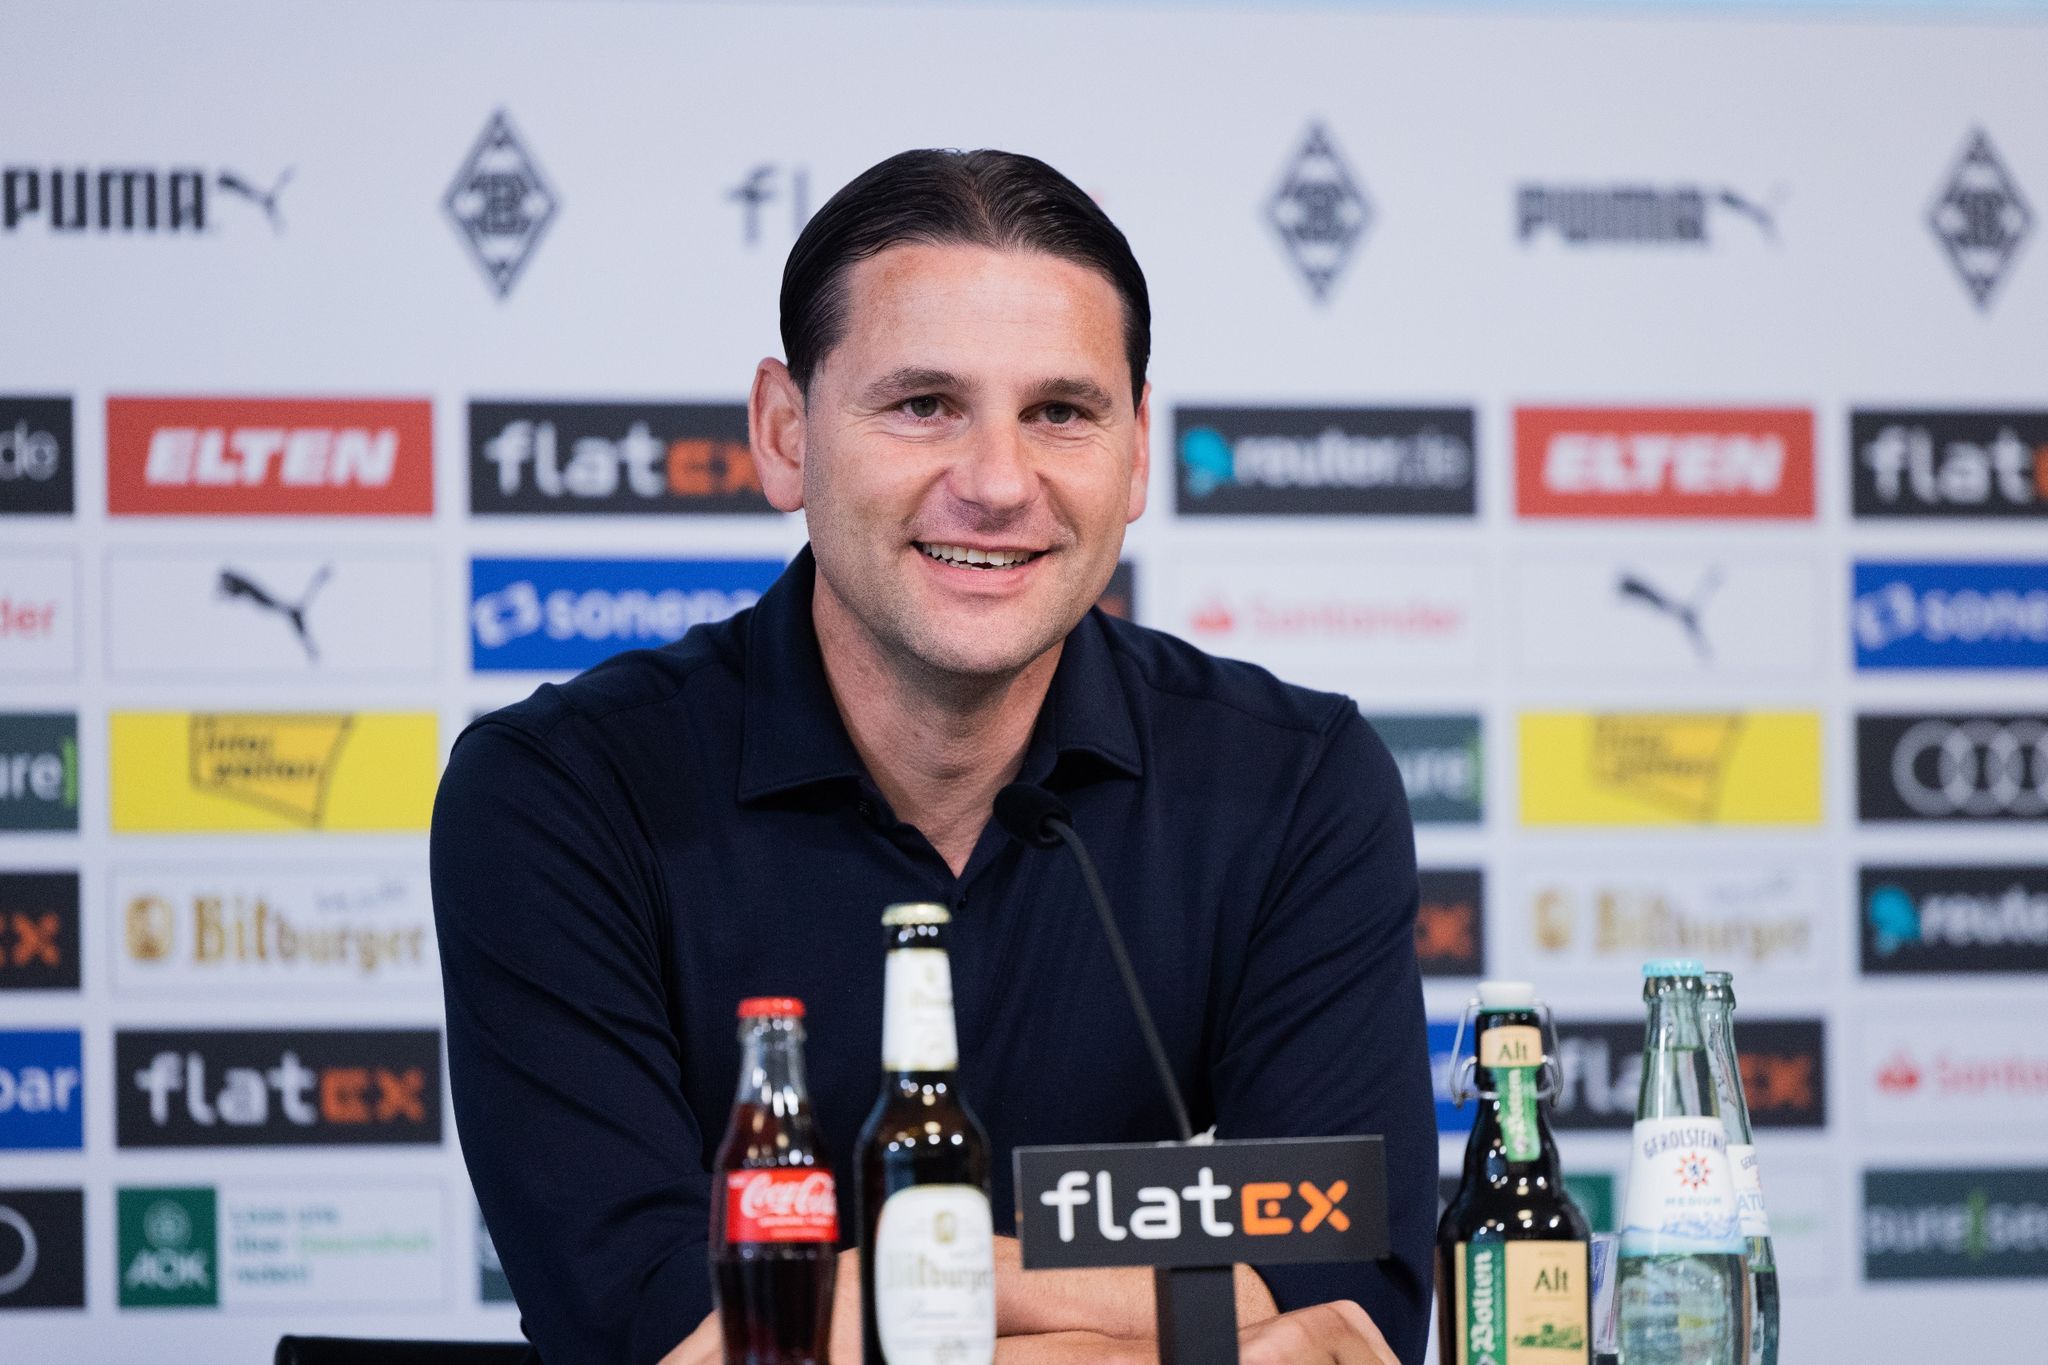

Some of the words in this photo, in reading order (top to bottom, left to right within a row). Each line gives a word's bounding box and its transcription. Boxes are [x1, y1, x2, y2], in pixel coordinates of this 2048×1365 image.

[2, 168, 206, 231] PUMA
[145, 427, 398, 487] ELTEN
[1543, 433, 1787, 494] ELTEN
[1499, 1041, 1528, 1061] Alt
[125, 1247, 208, 1289] AOK
[1534, 1266, 1568, 1291] Alt
